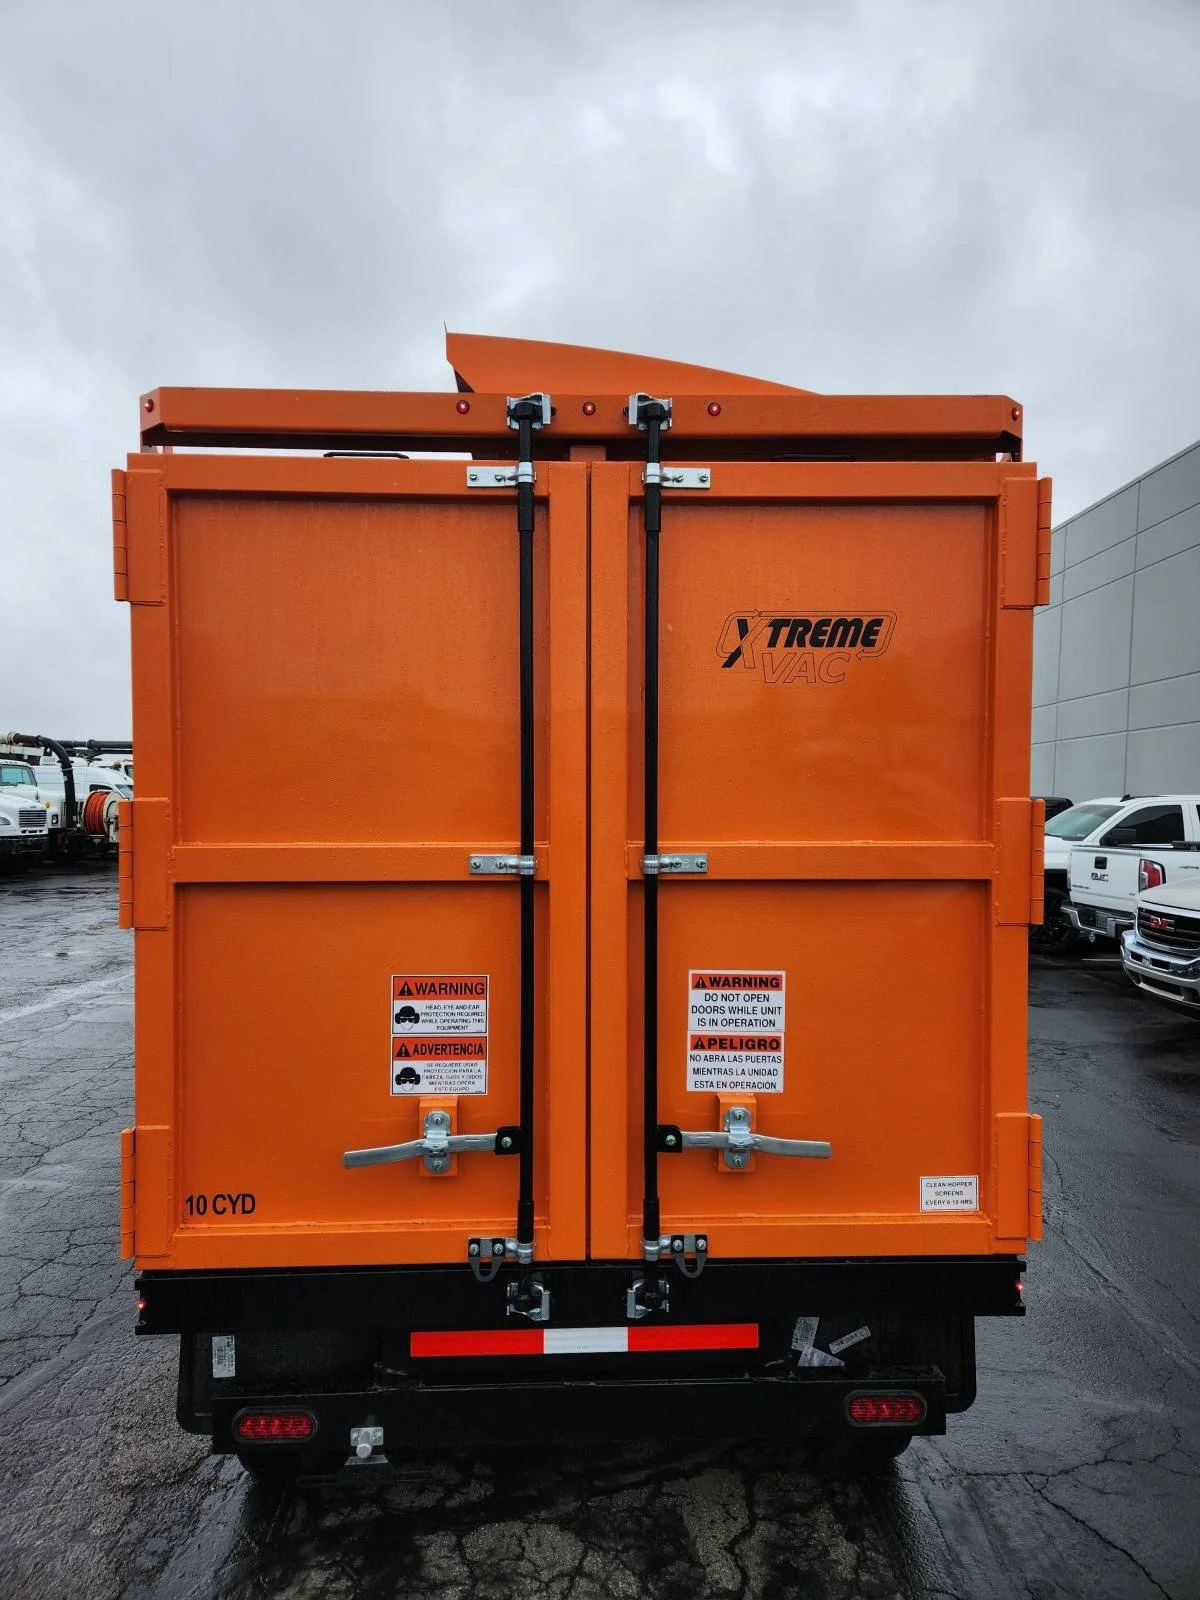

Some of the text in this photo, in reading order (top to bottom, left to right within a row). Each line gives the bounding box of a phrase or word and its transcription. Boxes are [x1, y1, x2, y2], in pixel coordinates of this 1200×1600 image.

[721, 617, 884, 669] XTREME
[762, 651, 851, 684] VAC
[709, 976, 780, 988] WARNING
[415, 982, 485, 996] WARNING
[704, 993, 770, 1003] DO NOT OPEN
[691, 1005, 782, 1015] DOORS WHILE UNIT
[697, 1018, 776, 1028] IS IN OPERATION
[412, 1043, 484, 1056] ADVERTENCIA
[707, 1038, 780, 1050] PELIGRO
[689, 1054, 782, 1064] NO ABRA LAS PUERTAS
[692, 1067, 778, 1077] MIENTRAS LA UNIDAD
[694, 1081, 777, 1090] ESTA EN OPERACION
[185, 1193, 256, 1216] 10 CYD
